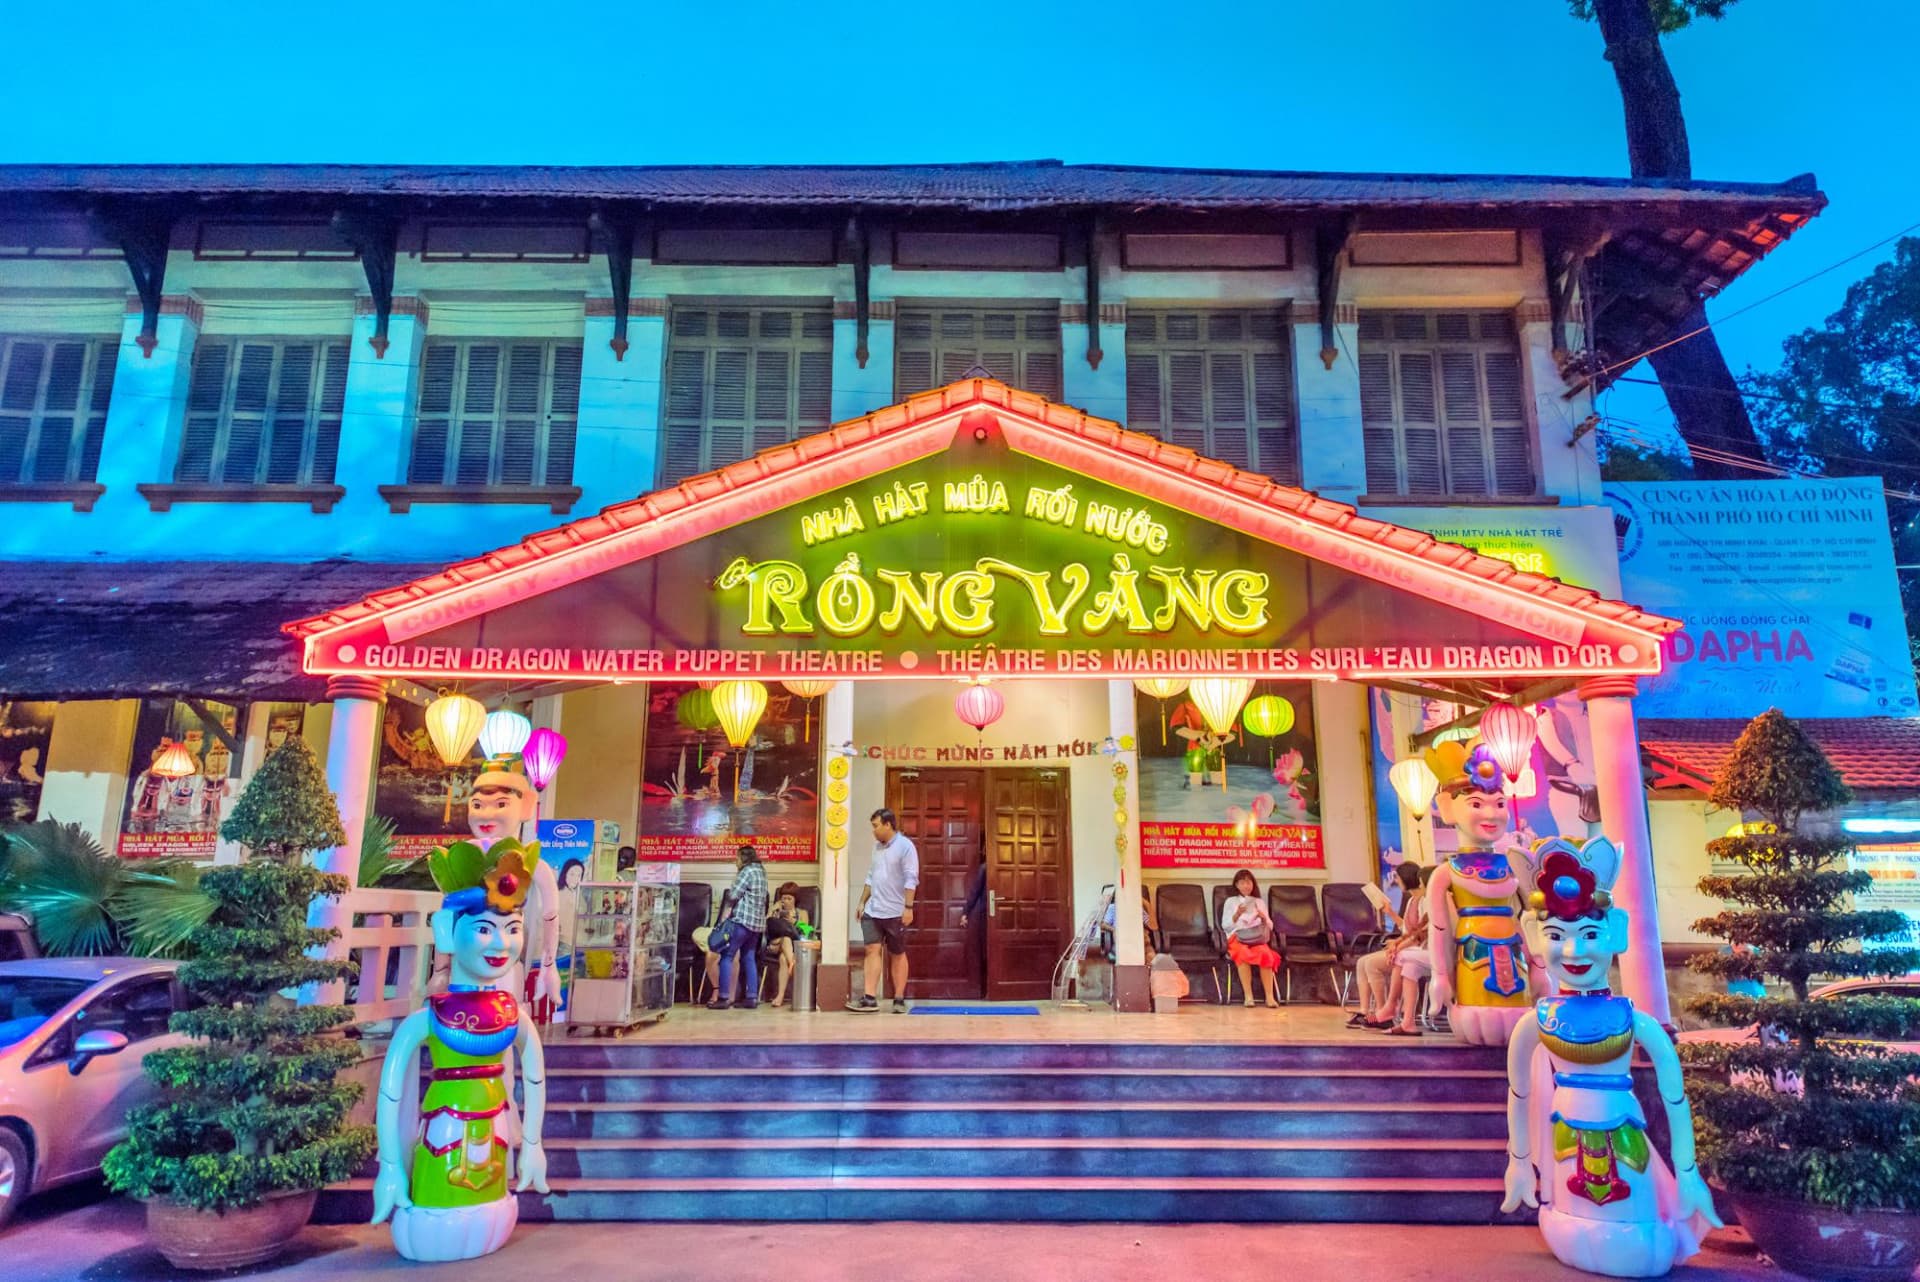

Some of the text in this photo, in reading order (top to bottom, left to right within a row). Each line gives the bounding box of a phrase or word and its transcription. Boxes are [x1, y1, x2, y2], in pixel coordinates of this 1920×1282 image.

[1642, 489, 1692, 503] CUNG
[1780, 488, 1817, 502] LAO
[801, 474, 1168, 555] NHÀ HÁT MÚA RỐI NƯỚC
[1825, 508, 1873, 523] MINH
[1462, 529, 1484, 537] MTV
[720, 552, 1269, 635] RỒNG VÀNG
[1669, 629, 1814, 662] DAPHA
[364, 644, 460, 669] GOLDEN
[470, 648, 570, 671] DRAGON
[582, 650, 663, 672] WATER
[675, 650, 765, 672] PUPPET
[777, 650, 883, 672] THEATRE
[937, 643, 1045, 672] THÉÂTRE
[1057, 649, 1101, 671] DES
[1113, 648, 1299, 671] MARIONNETTES
[1451, 645, 1542, 669] DRAGON
[1553, 644, 1613, 668] D'OR
[1003, 743, 1047, 760] NĂM
[1144, 838, 1176, 846] GOLDEN
[1179, 839, 1212, 847] DRAGON
[1215, 840, 1244, 848] WATER
